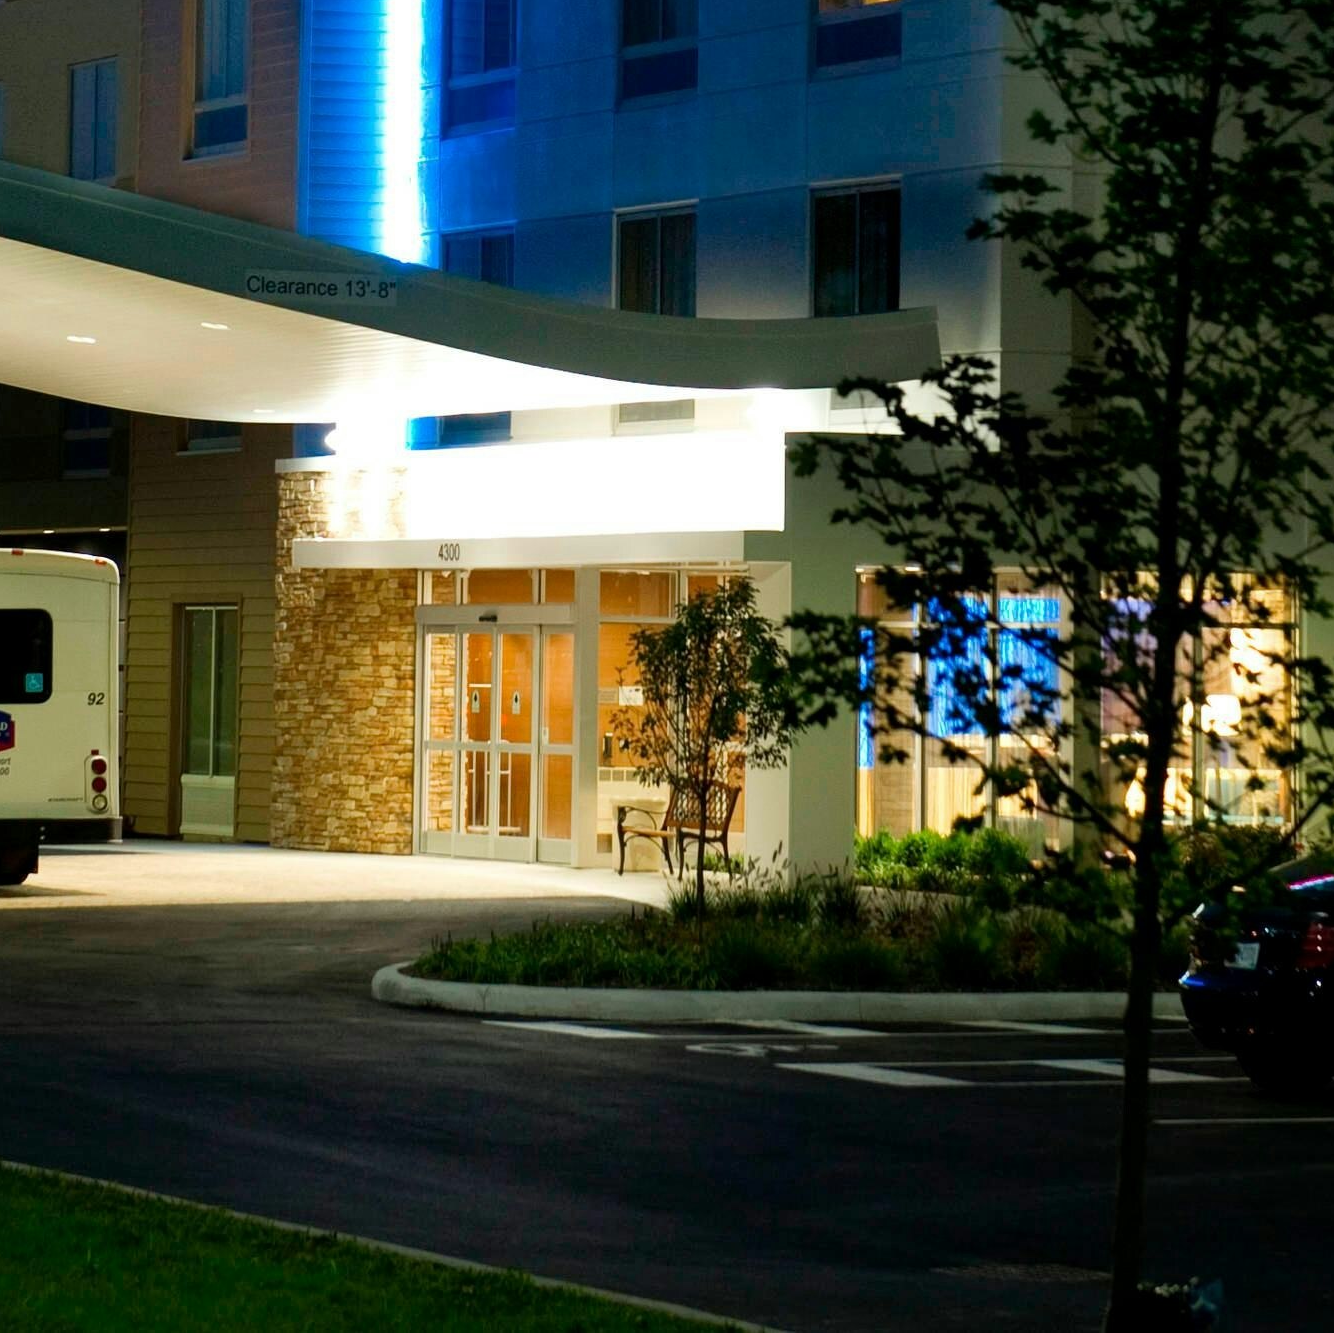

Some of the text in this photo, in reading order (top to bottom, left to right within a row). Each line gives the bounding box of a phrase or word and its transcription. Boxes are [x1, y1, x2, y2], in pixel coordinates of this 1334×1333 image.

[246, 275, 397, 299] Clearance 13'-8"
[438, 542, 461, 562] 4300
[87, 691, 105, 706] 92
